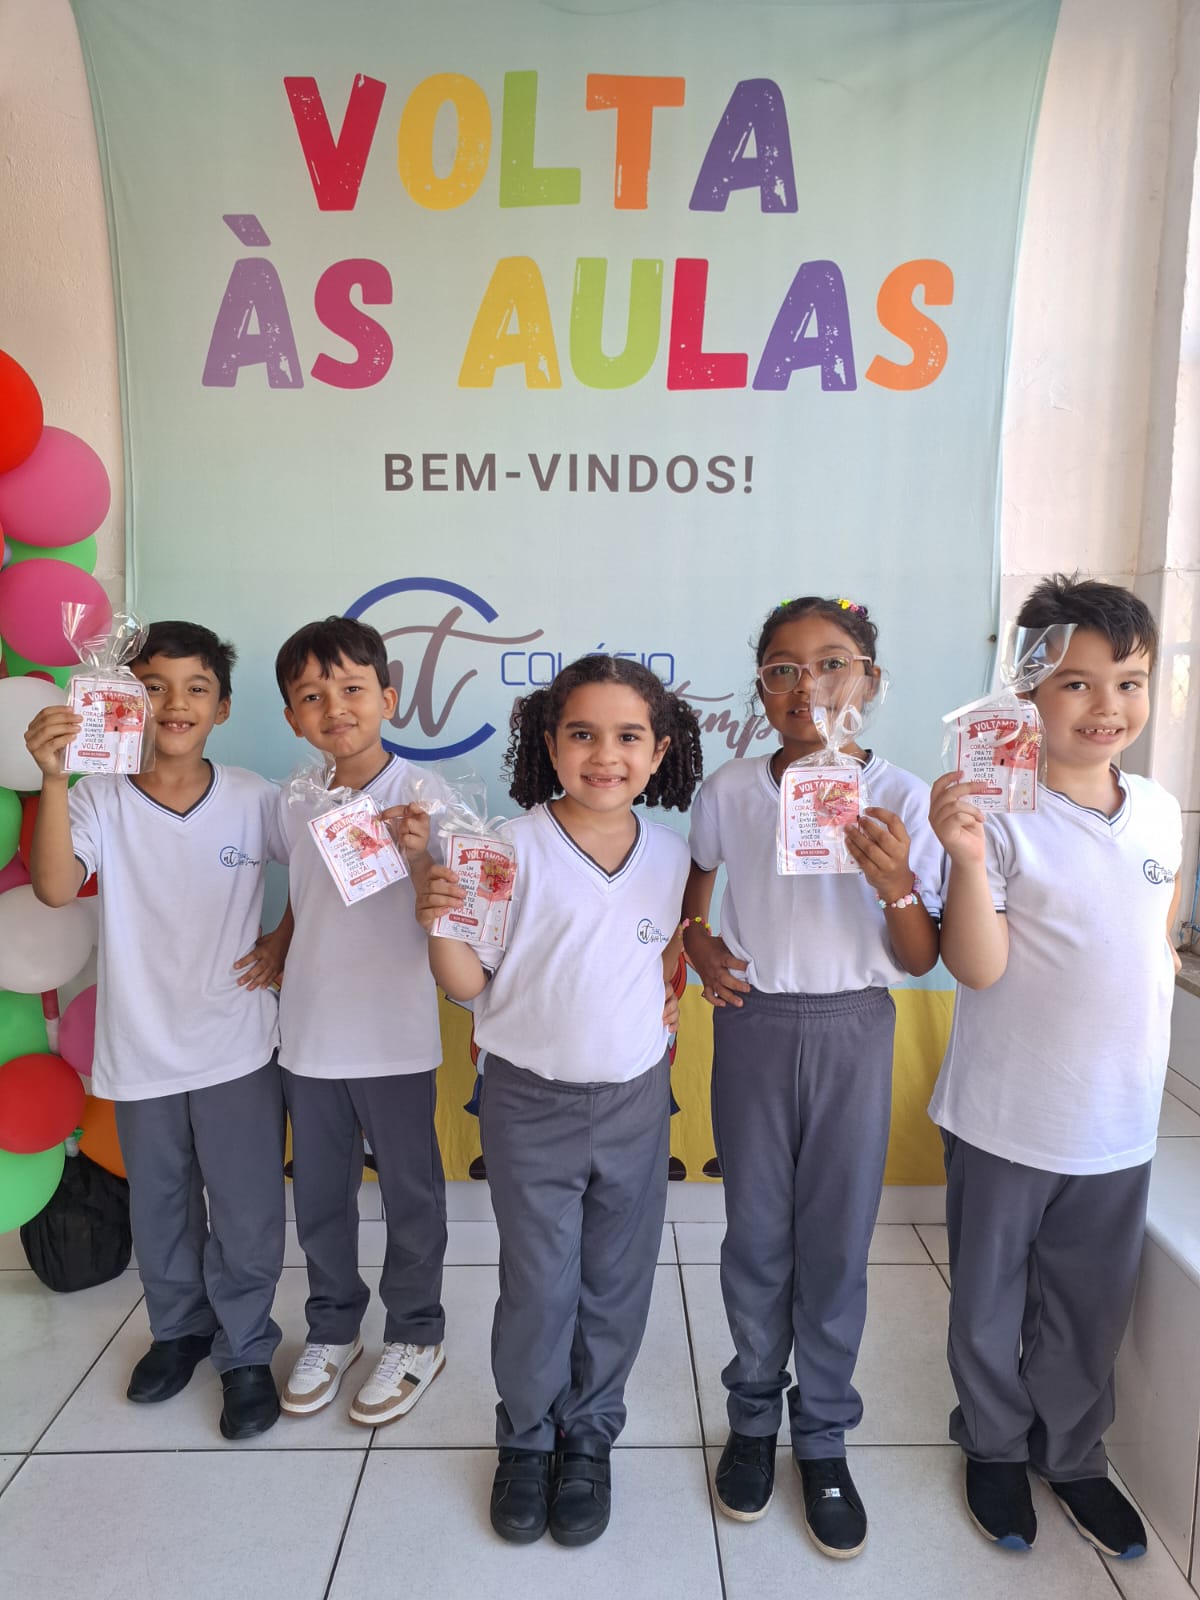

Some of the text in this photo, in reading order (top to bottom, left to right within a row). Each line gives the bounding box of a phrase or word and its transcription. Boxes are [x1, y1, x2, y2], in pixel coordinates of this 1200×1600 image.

[284, 70, 798, 213] VOLTA
[202, 213, 954, 390] ÀS AULAS
[384, 454, 753, 493] BEM-VINDOS!
[501, 642, 675, 686] COLIO
